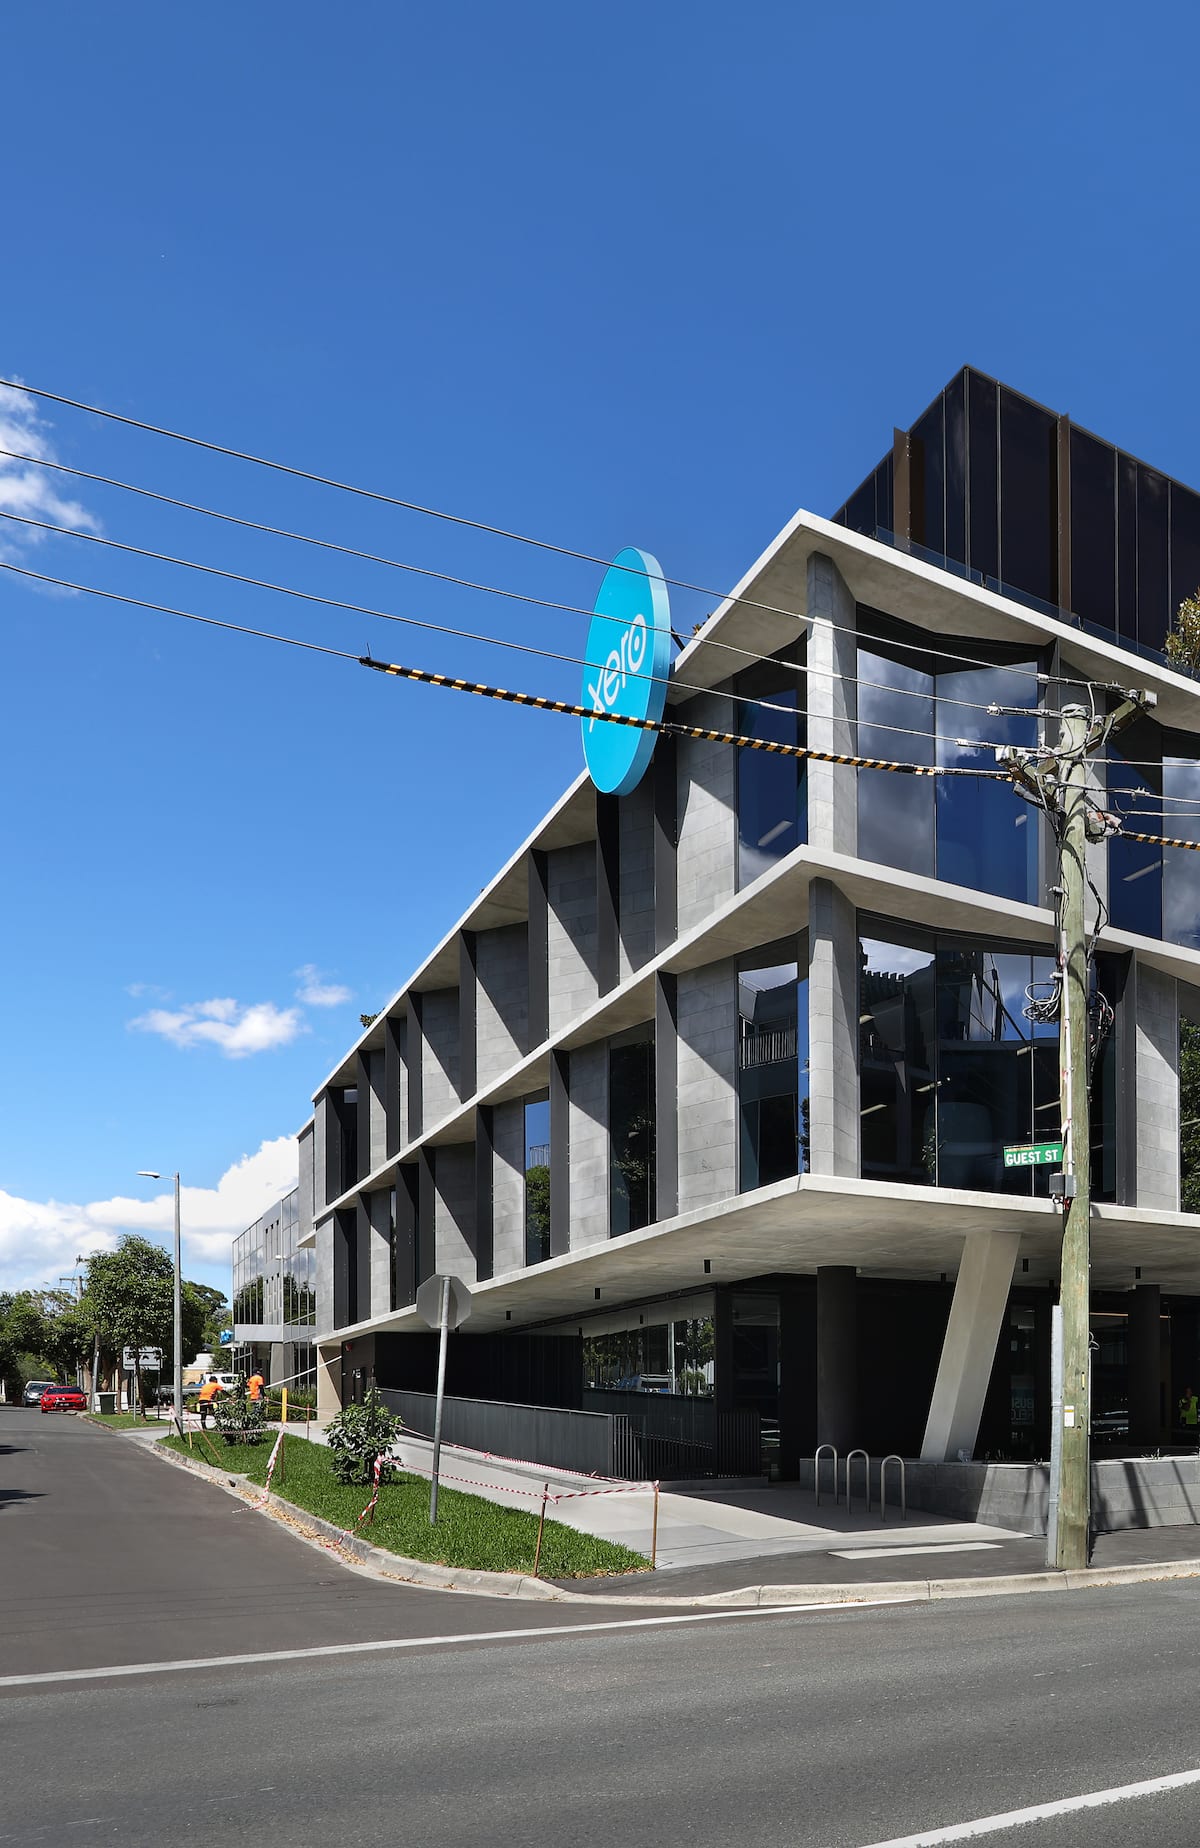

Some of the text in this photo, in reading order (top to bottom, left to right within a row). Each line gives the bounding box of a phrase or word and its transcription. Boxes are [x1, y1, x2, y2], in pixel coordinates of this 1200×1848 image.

[588, 613, 647, 733] xero
[1006, 1151, 1041, 1165] GUEST
[1045, 1149, 1058, 1161] ST
